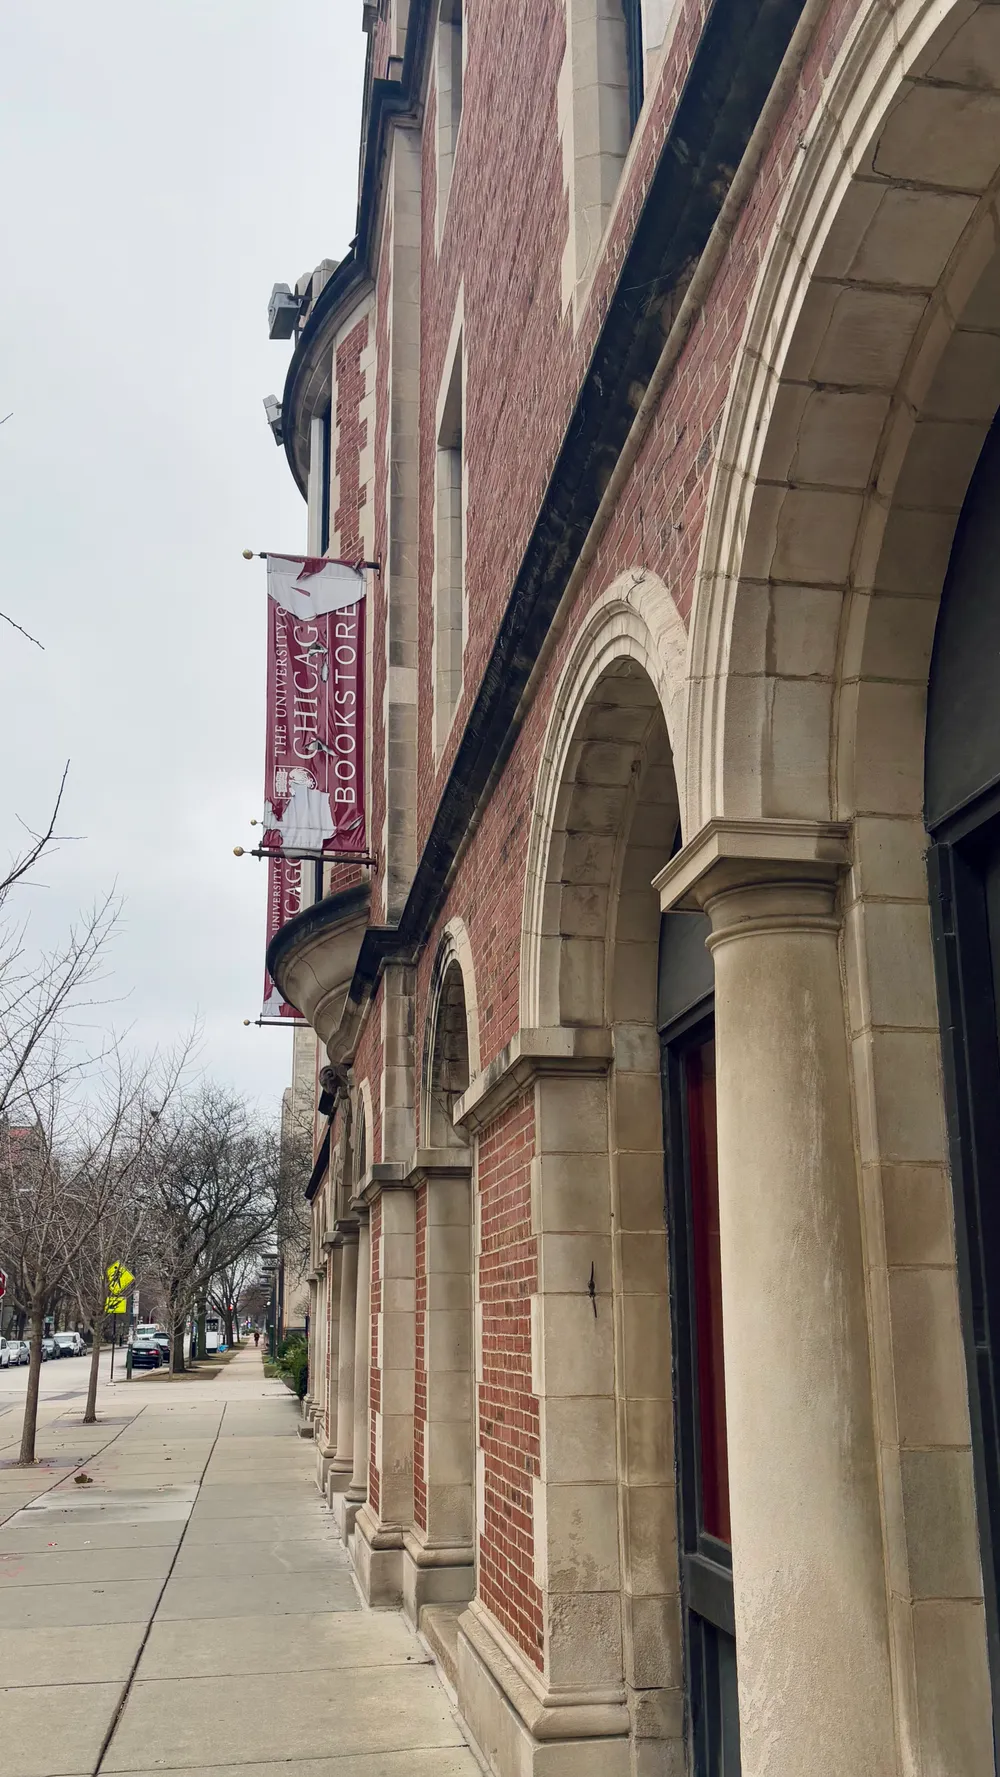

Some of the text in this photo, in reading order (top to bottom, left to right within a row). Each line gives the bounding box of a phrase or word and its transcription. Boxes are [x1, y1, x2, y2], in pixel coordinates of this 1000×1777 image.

[276, 605, 288, 617] O
[276, 622, 288, 718] UNIVERSITY
[293, 616, 318, 760] CHICAG
[335, 605, 356, 804] BOOKSTORE
[275, 725, 287, 757] THE
[272, 867, 282, 930] UNIVERSITY
